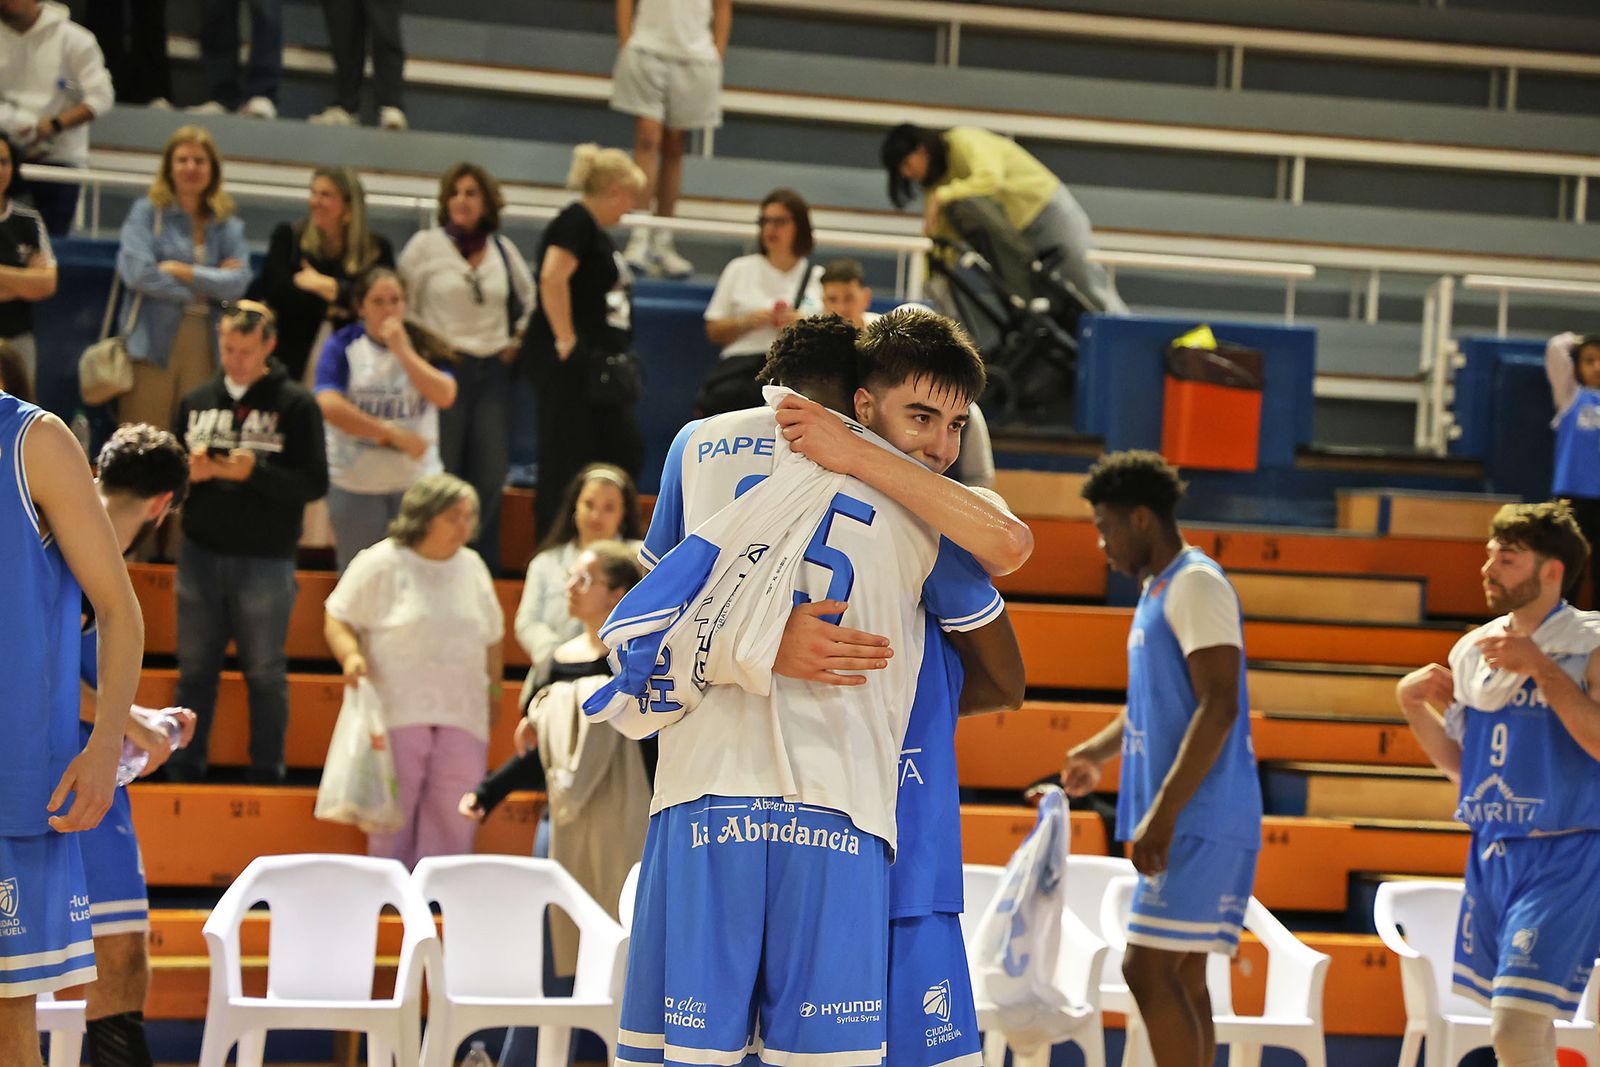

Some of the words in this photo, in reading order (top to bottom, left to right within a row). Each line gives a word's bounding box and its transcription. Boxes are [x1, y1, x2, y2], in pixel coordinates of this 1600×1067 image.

[699, 436, 776, 464] PAPE
[1489, 723, 1508, 767] 9
[690, 821, 710, 848] La
[925, 1022, 953, 1038] CIUDAD
[926, 1037, 938, 1047] DE
[938, 1029, 962, 1044] HUELVA
